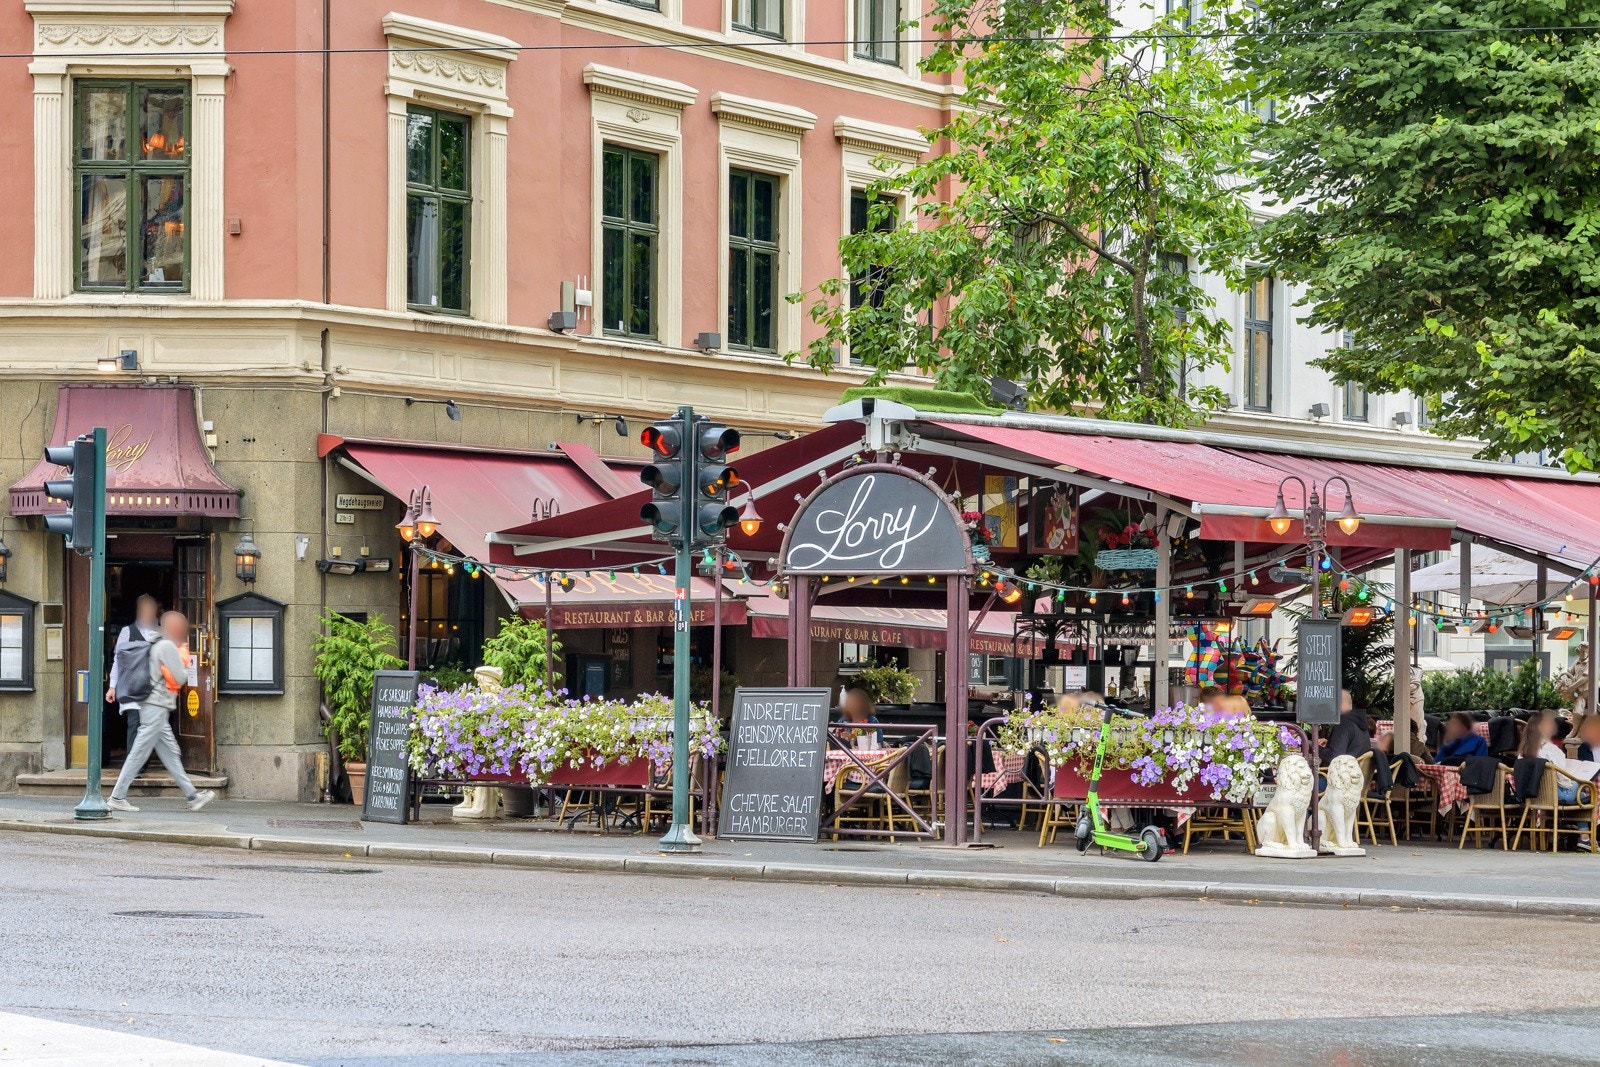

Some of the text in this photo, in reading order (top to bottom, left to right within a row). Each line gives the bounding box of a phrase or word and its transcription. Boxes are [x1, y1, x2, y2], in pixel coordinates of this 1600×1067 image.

[787, 475, 940, 569] Lorry
[564, 611, 631, 625] RESTAURANT
[633, 610, 643, 623] &
[646, 610, 664, 623] BAR
[854, 629, 870, 641] BAR
[1027, 644, 1040, 656] BR
[1305, 634, 1333, 657] STEKT
[743, 702, 822, 721] INDREFILET
[735, 748, 817, 768] FJELLØRRET
[730, 793, 815, 814] CHEVRE SALAT
